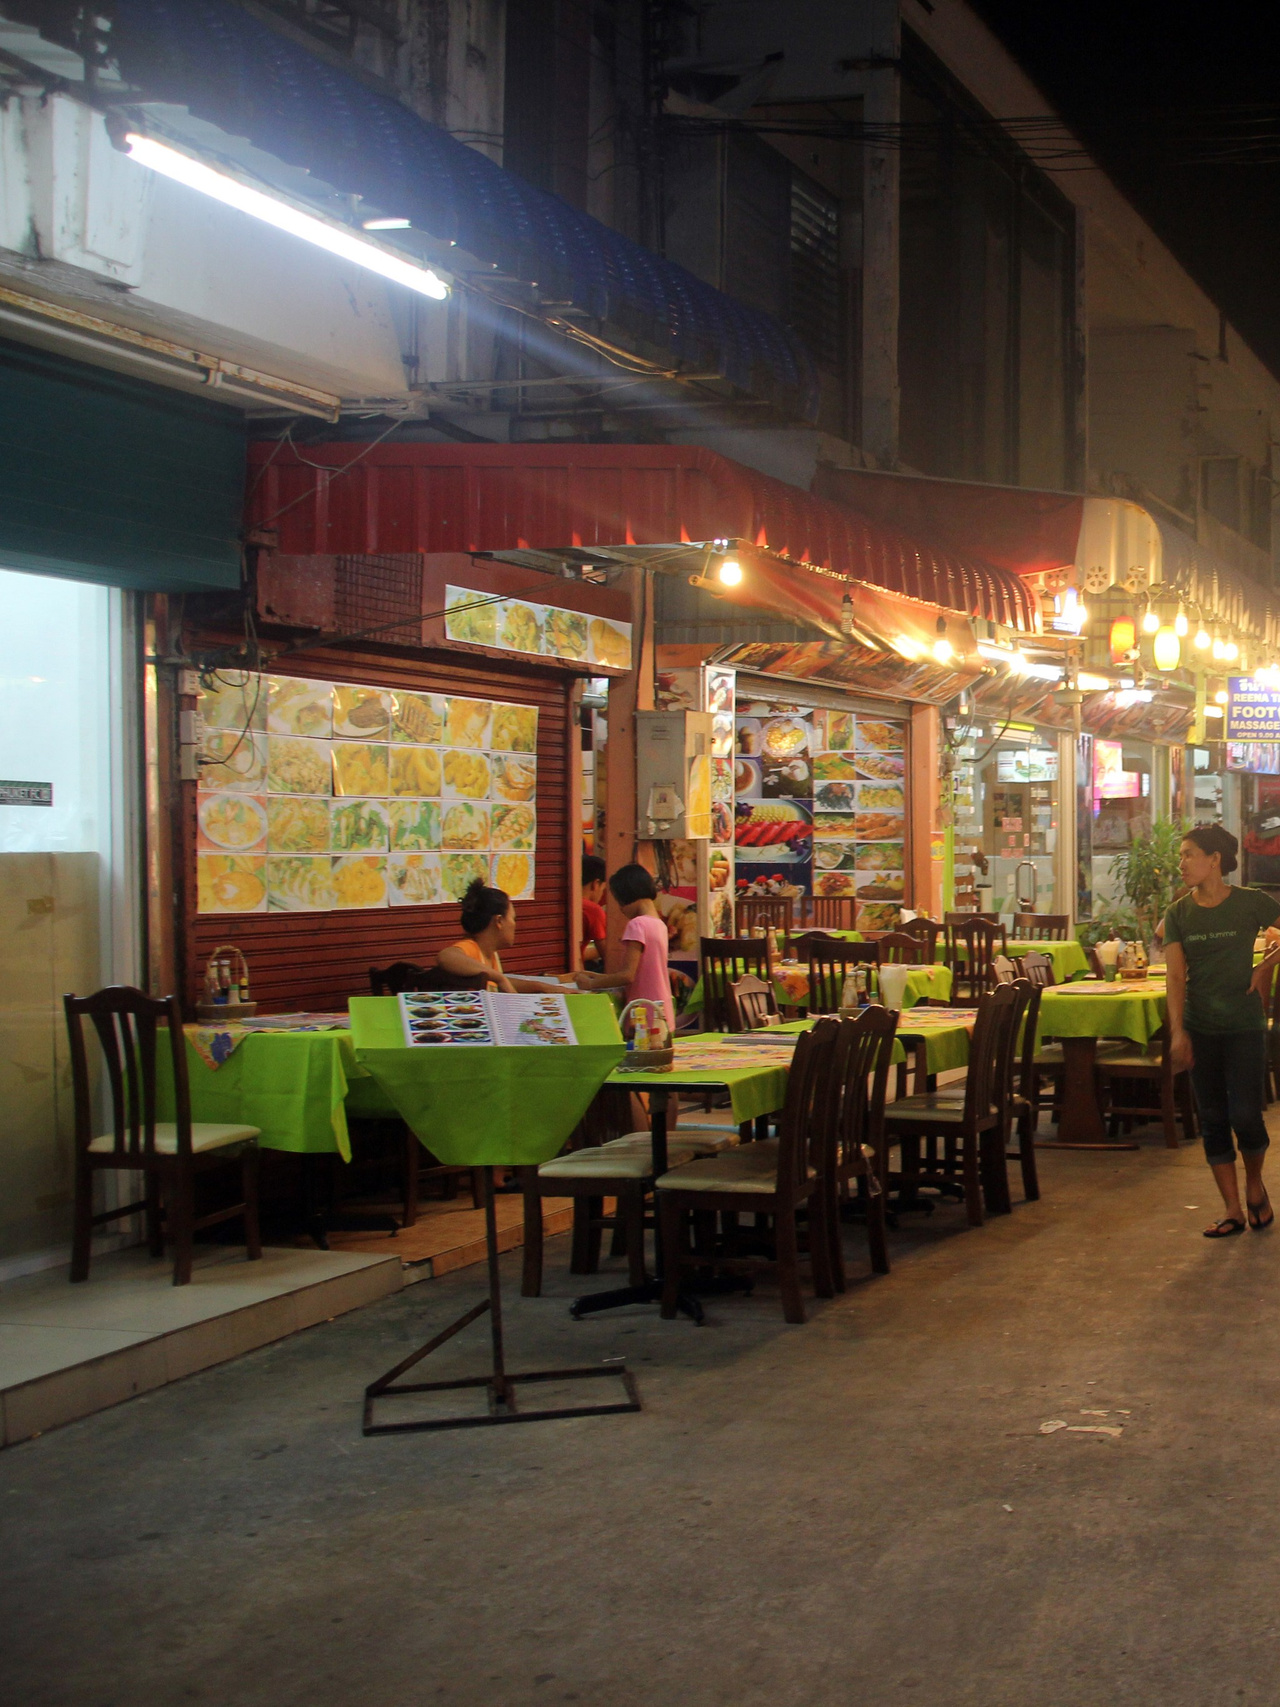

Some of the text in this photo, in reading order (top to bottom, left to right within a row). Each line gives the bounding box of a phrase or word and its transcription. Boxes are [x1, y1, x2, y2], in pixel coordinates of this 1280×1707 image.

[1233, 693, 1269, 703] REENA
[1232, 706, 1278, 719] FOOT
[1230, 720, 1280, 730] MASSAGE
[1236, 731, 1257, 739] OPEN
